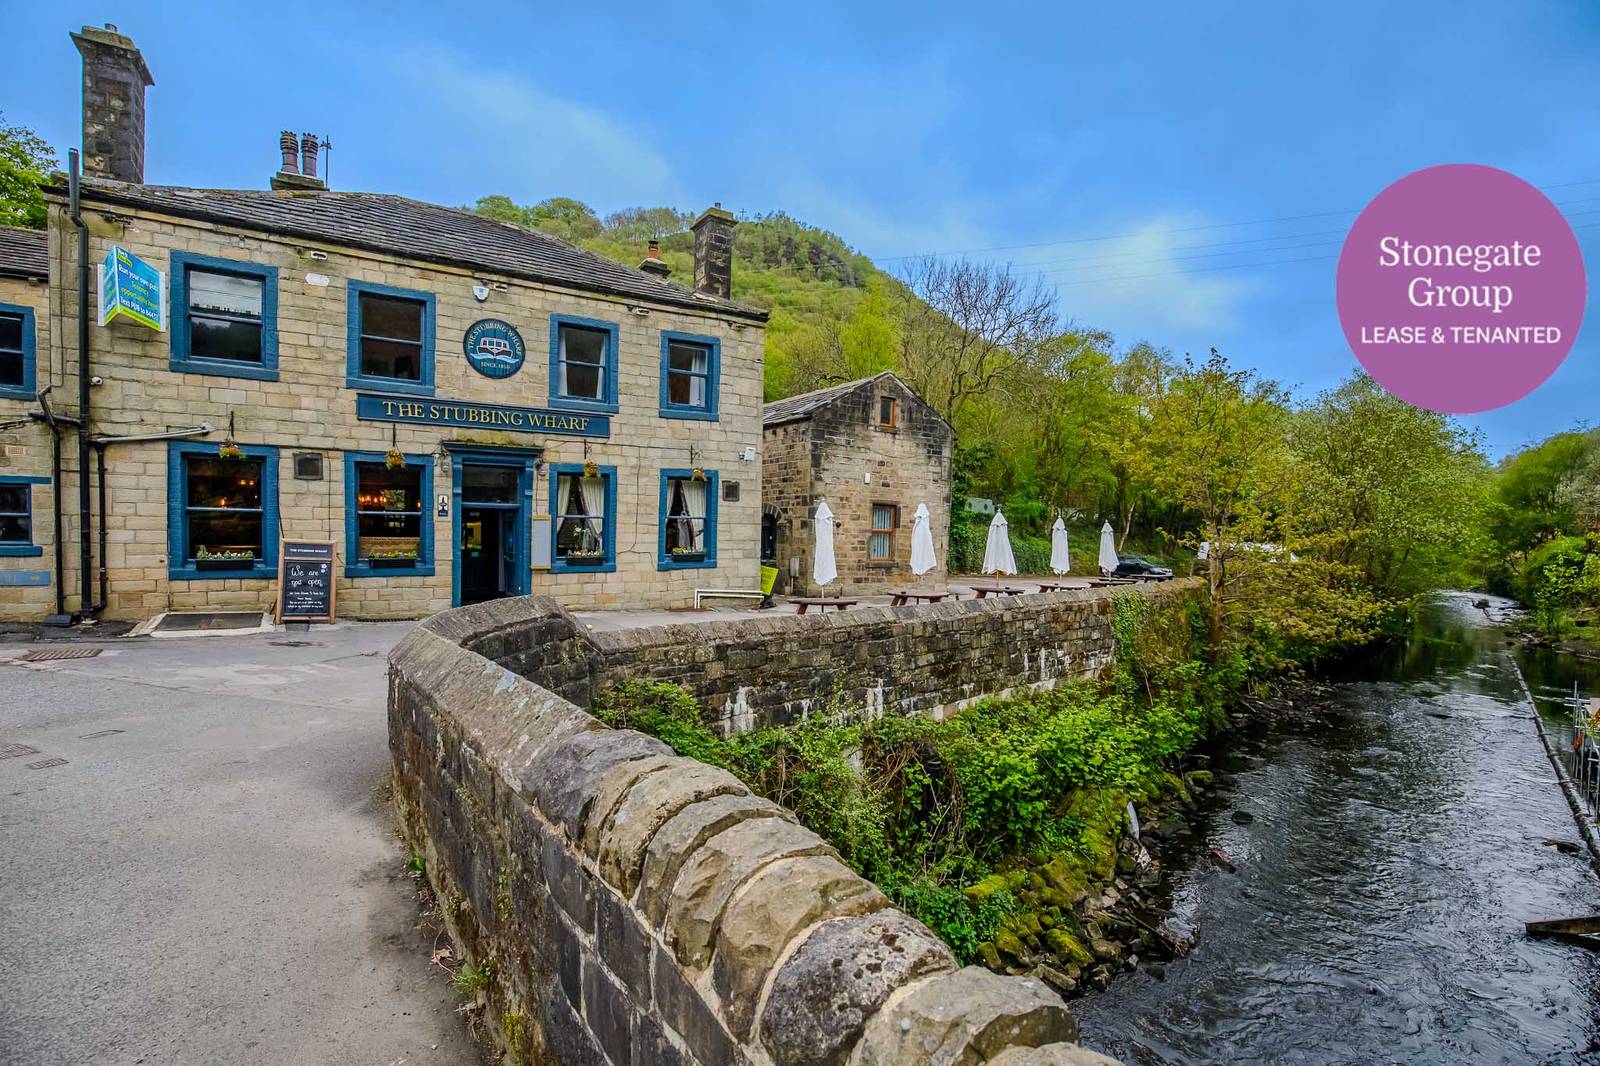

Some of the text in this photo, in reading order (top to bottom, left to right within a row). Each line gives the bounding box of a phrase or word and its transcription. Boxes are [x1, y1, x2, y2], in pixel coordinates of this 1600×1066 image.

[467, 322, 522, 355] THE STUBBING WHARF
[382, 401, 590, 431] THE STUBBING WHARF
[291, 564, 304, 577] We
